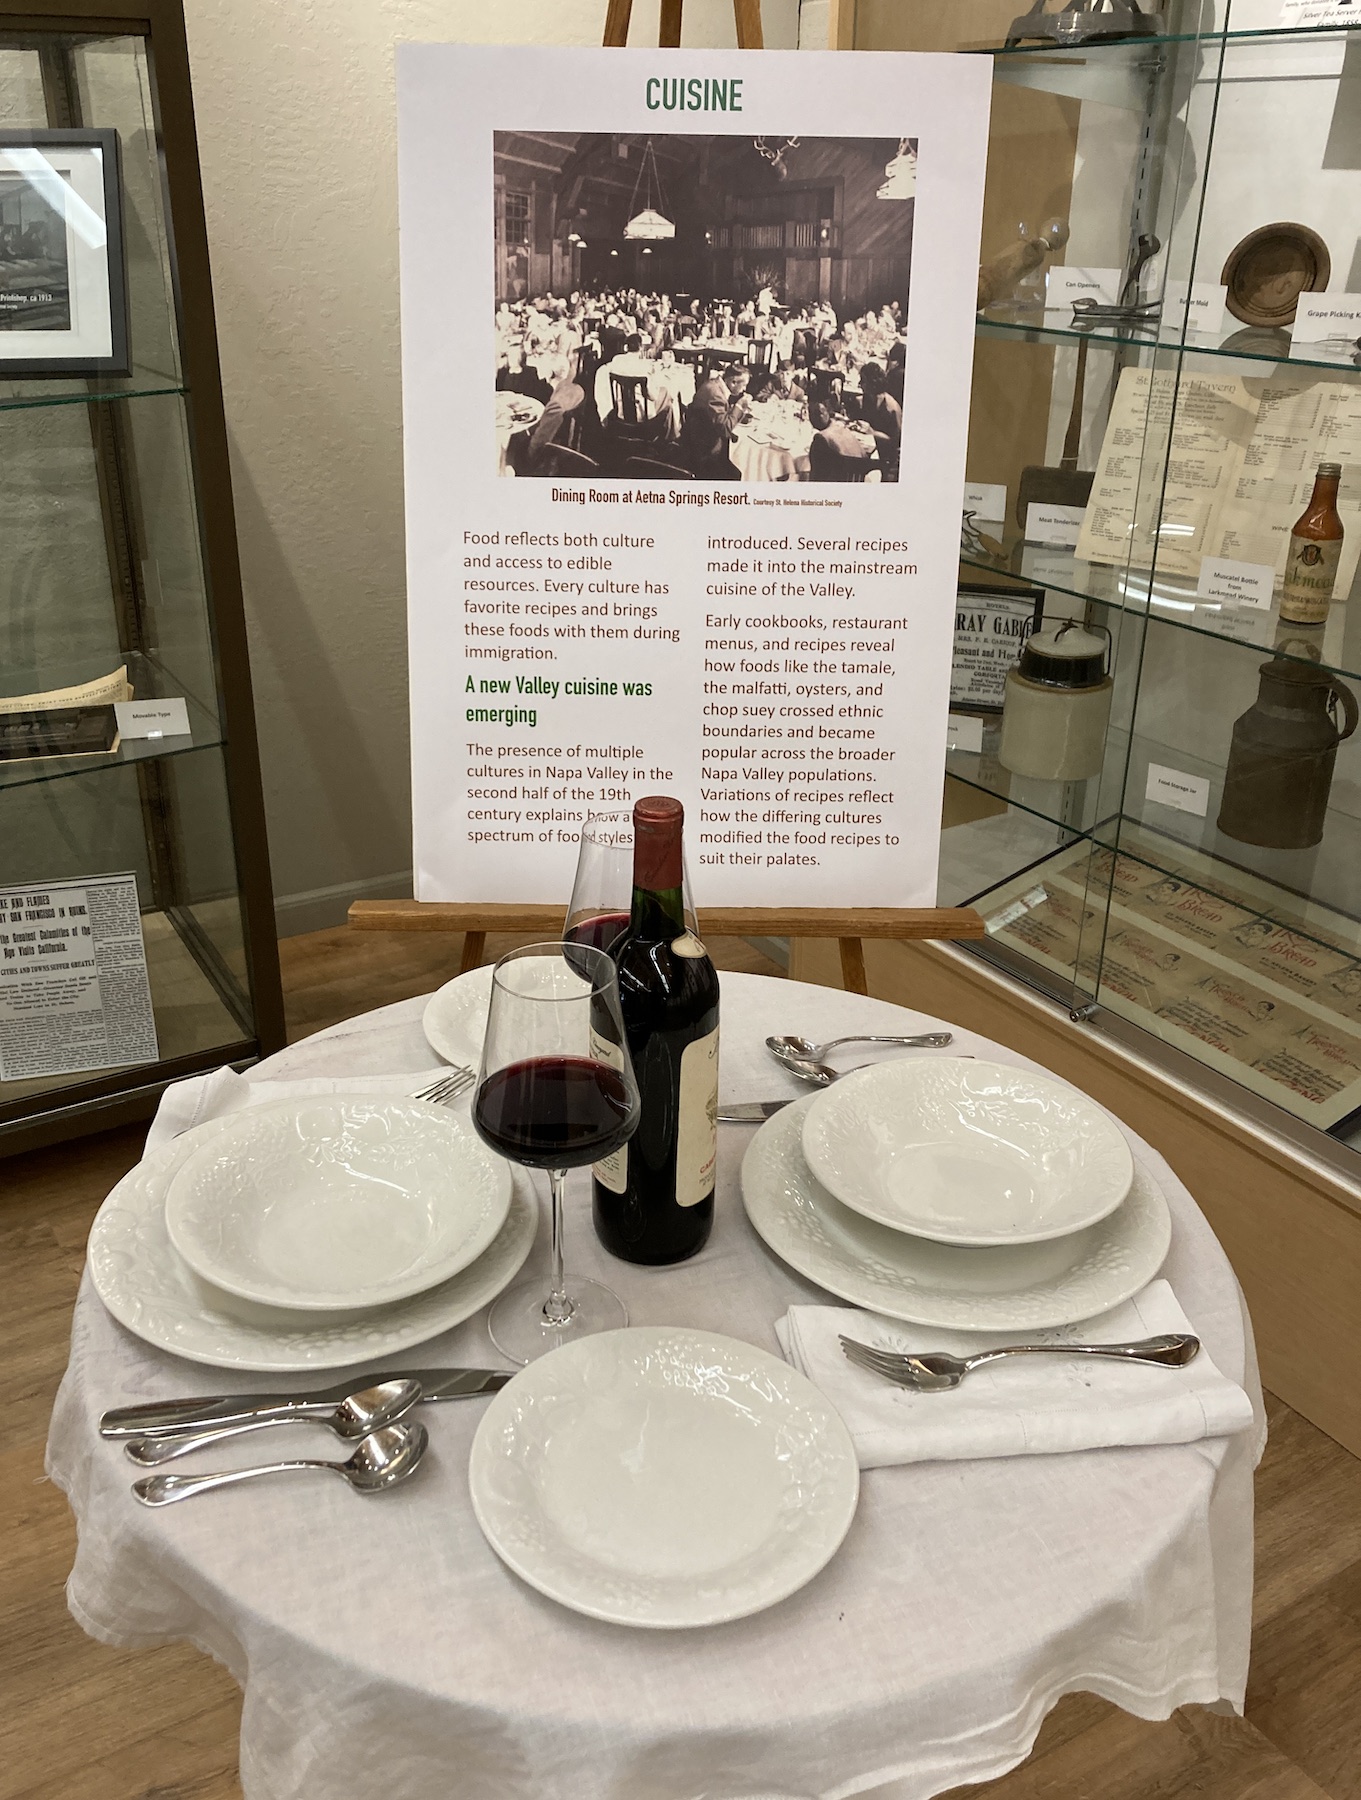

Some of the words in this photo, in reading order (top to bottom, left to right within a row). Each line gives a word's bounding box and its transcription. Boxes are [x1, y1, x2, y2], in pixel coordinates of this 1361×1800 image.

[647, 78, 743, 111] CUISINE
[1077, 282, 1100, 290] Openers
[1179, 298, 1195, 306] Buer
[1307, 310, 1328, 318] Grape
[1330, 311, 1354, 319] Picking
[552, 488, 585, 504] Dining
[590, 489, 618, 502] Room
[623, 491, 632, 503] at
[636, 490, 665, 503] Aetna
[669, 491, 709, 506] Springs
[714, 491, 750, 504] Resort.
[1053, 518, 1081, 526] Tenderizer
[464, 531, 499, 544] Food
[505, 532, 558, 546] reflects
[564, 533, 597, 546] both
[603, 534, 654, 547] culture
[709, 536, 792, 549] introduced.
[798, 537, 850, 550] Several
[856, 538, 907, 554] recipes
[464, 554, 490, 567] and
[496, 558, 542, 568] access
[548, 557, 562, 569] to
[567, 556, 611, 570] edible
[708, 559, 748, 572] made
[754, 561, 762, 572] it
[768, 560, 795, 572] into
[801, 560, 824, 573] the
[830, 561, 917, 574] mainstream
[465, 581, 538, 591] resources.
[545, 579, 583, 595] Every
[589, 580, 639, 593] culture
[645, 580, 669, 594] has
[1213, 572, 1240, 582] Muscatel
[1240, 576, 1259, 586] Bottle
[1227, 583, 1242, 591] from
[707, 582, 756, 595] cuisine
[762, 582, 777, 595] of
[781, 583, 804, 595] the
[810, 583, 855, 599] Valley.
[1208, 588, 1237, 600] Larkmead
[1237, 593, 1259, 604] Winery
[464, 600, 520, 614] favorite
[526, 602, 576, 618] recipes
[582, 603, 608, 615] and
[614, 603, 657, 619] brings
[707, 614, 740, 630] Early
[746, 615, 826, 630] cookbooks,
[833, 618, 907, 629] restaurant
[954, 612, 987, 633] RAY
[465, 622, 504, 636] these
[509, 623, 549, 637] foods
[554, 625, 585, 637] with
[591, 625, 628, 638] them
[634, 626, 679, 642] during
[466, 645, 557, 661] immigration.
[706, 640, 757, 652] menus,
[763, 638, 789, 650] and
[795, 638, 845, 653] recipes
[851, 639, 894, 651] reveal
[705, 659, 735, 671] how
[740, 659, 779, 672] foods
[785, 660, 808, 673] like
[813, 660, 836, 673] the
[842, 661, 895, 676] tamale,
[466, 675, 475, 692] A
[481, 680, 511, 693] new
[516, 676, 559, 699] Valley
[565, 677, 617, 695] cuisine
[623, 683, 652, 695] was
[704, 681, 727, 693] the
[733, 681, 790, 696] malfatti,
[796, 684, 850, 698] oysters,
[857, 683, 882, 695] and
[467, 705, 536, 727] emerging
[703, 703, 737, 718] chop
[743, 707, 775, 719] suey
[780, 704, 833, 717] crossed
[839, 705, 883, 717] ethnic
[703, 724, 782, 737] boundaries
[788, 726, 813, 738] and
[819, 726, 875, 739] became
[466, 743, 492, 756] The
[498, 747, 562, 759] presence
[567, 745, 581, 757] of
[586, 745, 643, 760] multiple
[703, 746, 757, 760] popular
[762, 750, 805, 759] across
[810, 747, 833, 759] the
[839, 748, 895, 760] broader
[467, 765, 524, 777] cultures
[529, 766, 540, 777] in
[547, 767, 582, 781] Napa
[587, 767, 628, 782] Valley
[634, 768, 644, 779] in
[650, 767, 672, 779] the
[702, 767, 737, 782] Napa
[743, 768, 784, 782] Valley
[789, 769, 876, 783] populations.
[468, 787, 516, 798] second
[523, 786, 549, 799] half
[553, 787, 567, 799] of
[571, 787, 594, 800] the
[600, 788, 630, 800] 19th
[701, 789, 770, 801] Variations
[775, 789, 789, 801] of
[794, 790, 843, 804] recipes
[849, 790, 893, 803] reflect
[468, 809, 521, 823] century
[526, 808, 582, 823] explains
[623, 814, 630, 823] a
[701, 809, 730, 821] how
[735, 810, 757, 822] the
[763, 810, 820, 825] differing
[826, 811, 881, 823] cultures
[468, 831, 533, 843] spectrum
[539, 829, 553, 842] of
[598, 831, 633, 846] styles
[701, 831, 762, 843] modified
[767, 831, 789, 843] the
[795, 832, 825, 844] food
[831, 833, 880, 847] recipes
[886, 834, 899, 845] to
[700, 853, 724, 864] suit
[729, 852, 762, 864] their
[767, 853, 820, 867] palates.
